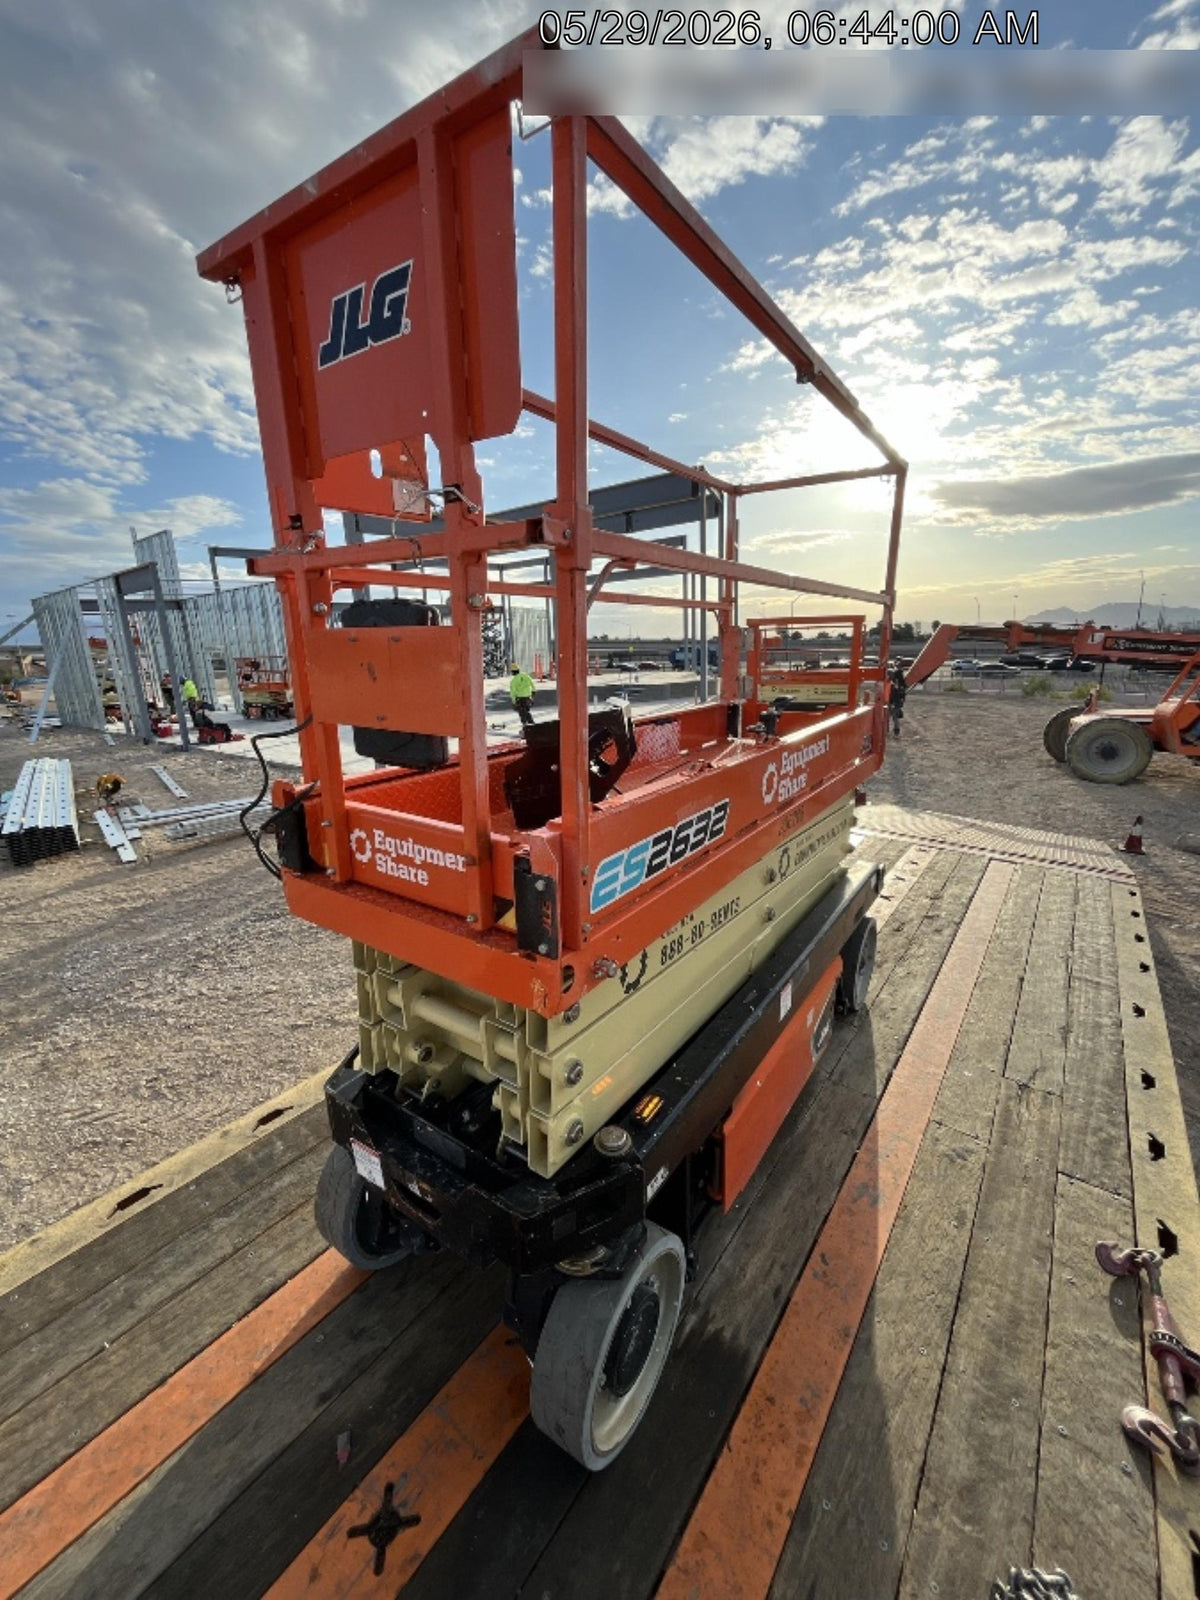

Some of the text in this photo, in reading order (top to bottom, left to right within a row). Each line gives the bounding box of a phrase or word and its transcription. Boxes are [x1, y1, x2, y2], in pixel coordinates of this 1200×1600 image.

[318, 259, 413, 370] JLG
[375, 853, 429, 886] Share
[590, 797, 730, 914] ES2632
